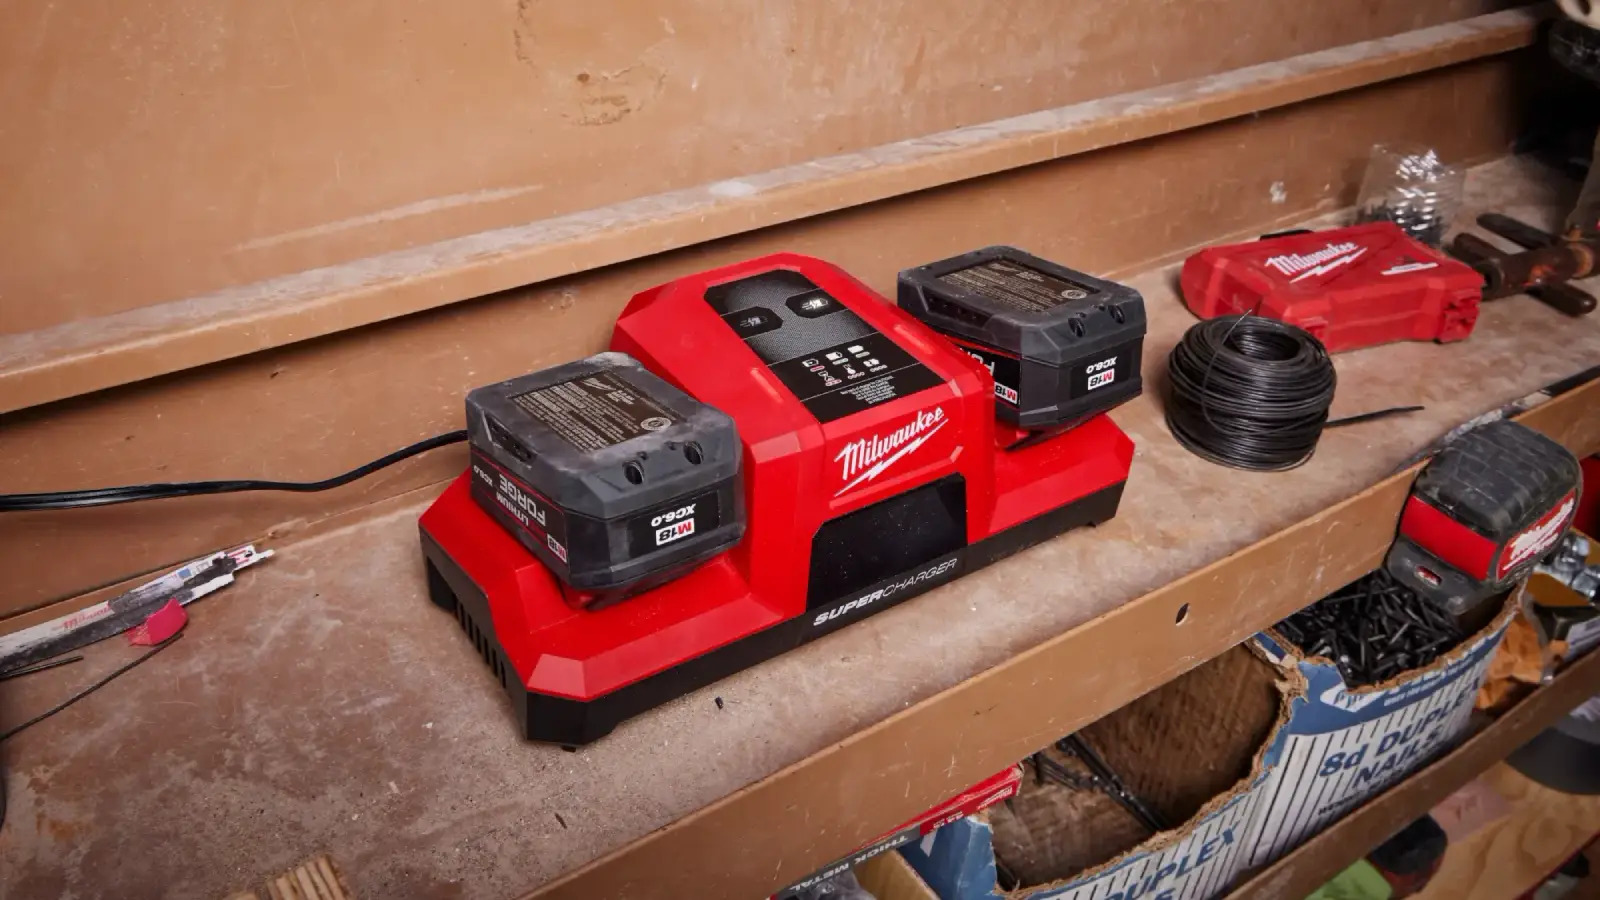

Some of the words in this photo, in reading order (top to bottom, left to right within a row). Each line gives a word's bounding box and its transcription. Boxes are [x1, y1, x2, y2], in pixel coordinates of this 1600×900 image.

[1264, 241, 1359, 276] Milwaukee
[994, 383, 1018, 402] M18
[1088, 369, 1114, 389] M18
[833, 406, 945, 481] Milwaukee
[496, 491, 529, 527] LITHIUM
[498, 473, 547, 527] FORGE
[650, 502, 697, 528] XC6.0
[657, 520, 695, 545] M18
[812, 557, 958, 627] SUPERCHARGER
[1319, 743, 1370, 777] 8d
[854, 834, 909, 866] THICK
[788, 862, 850, 892] METAL
